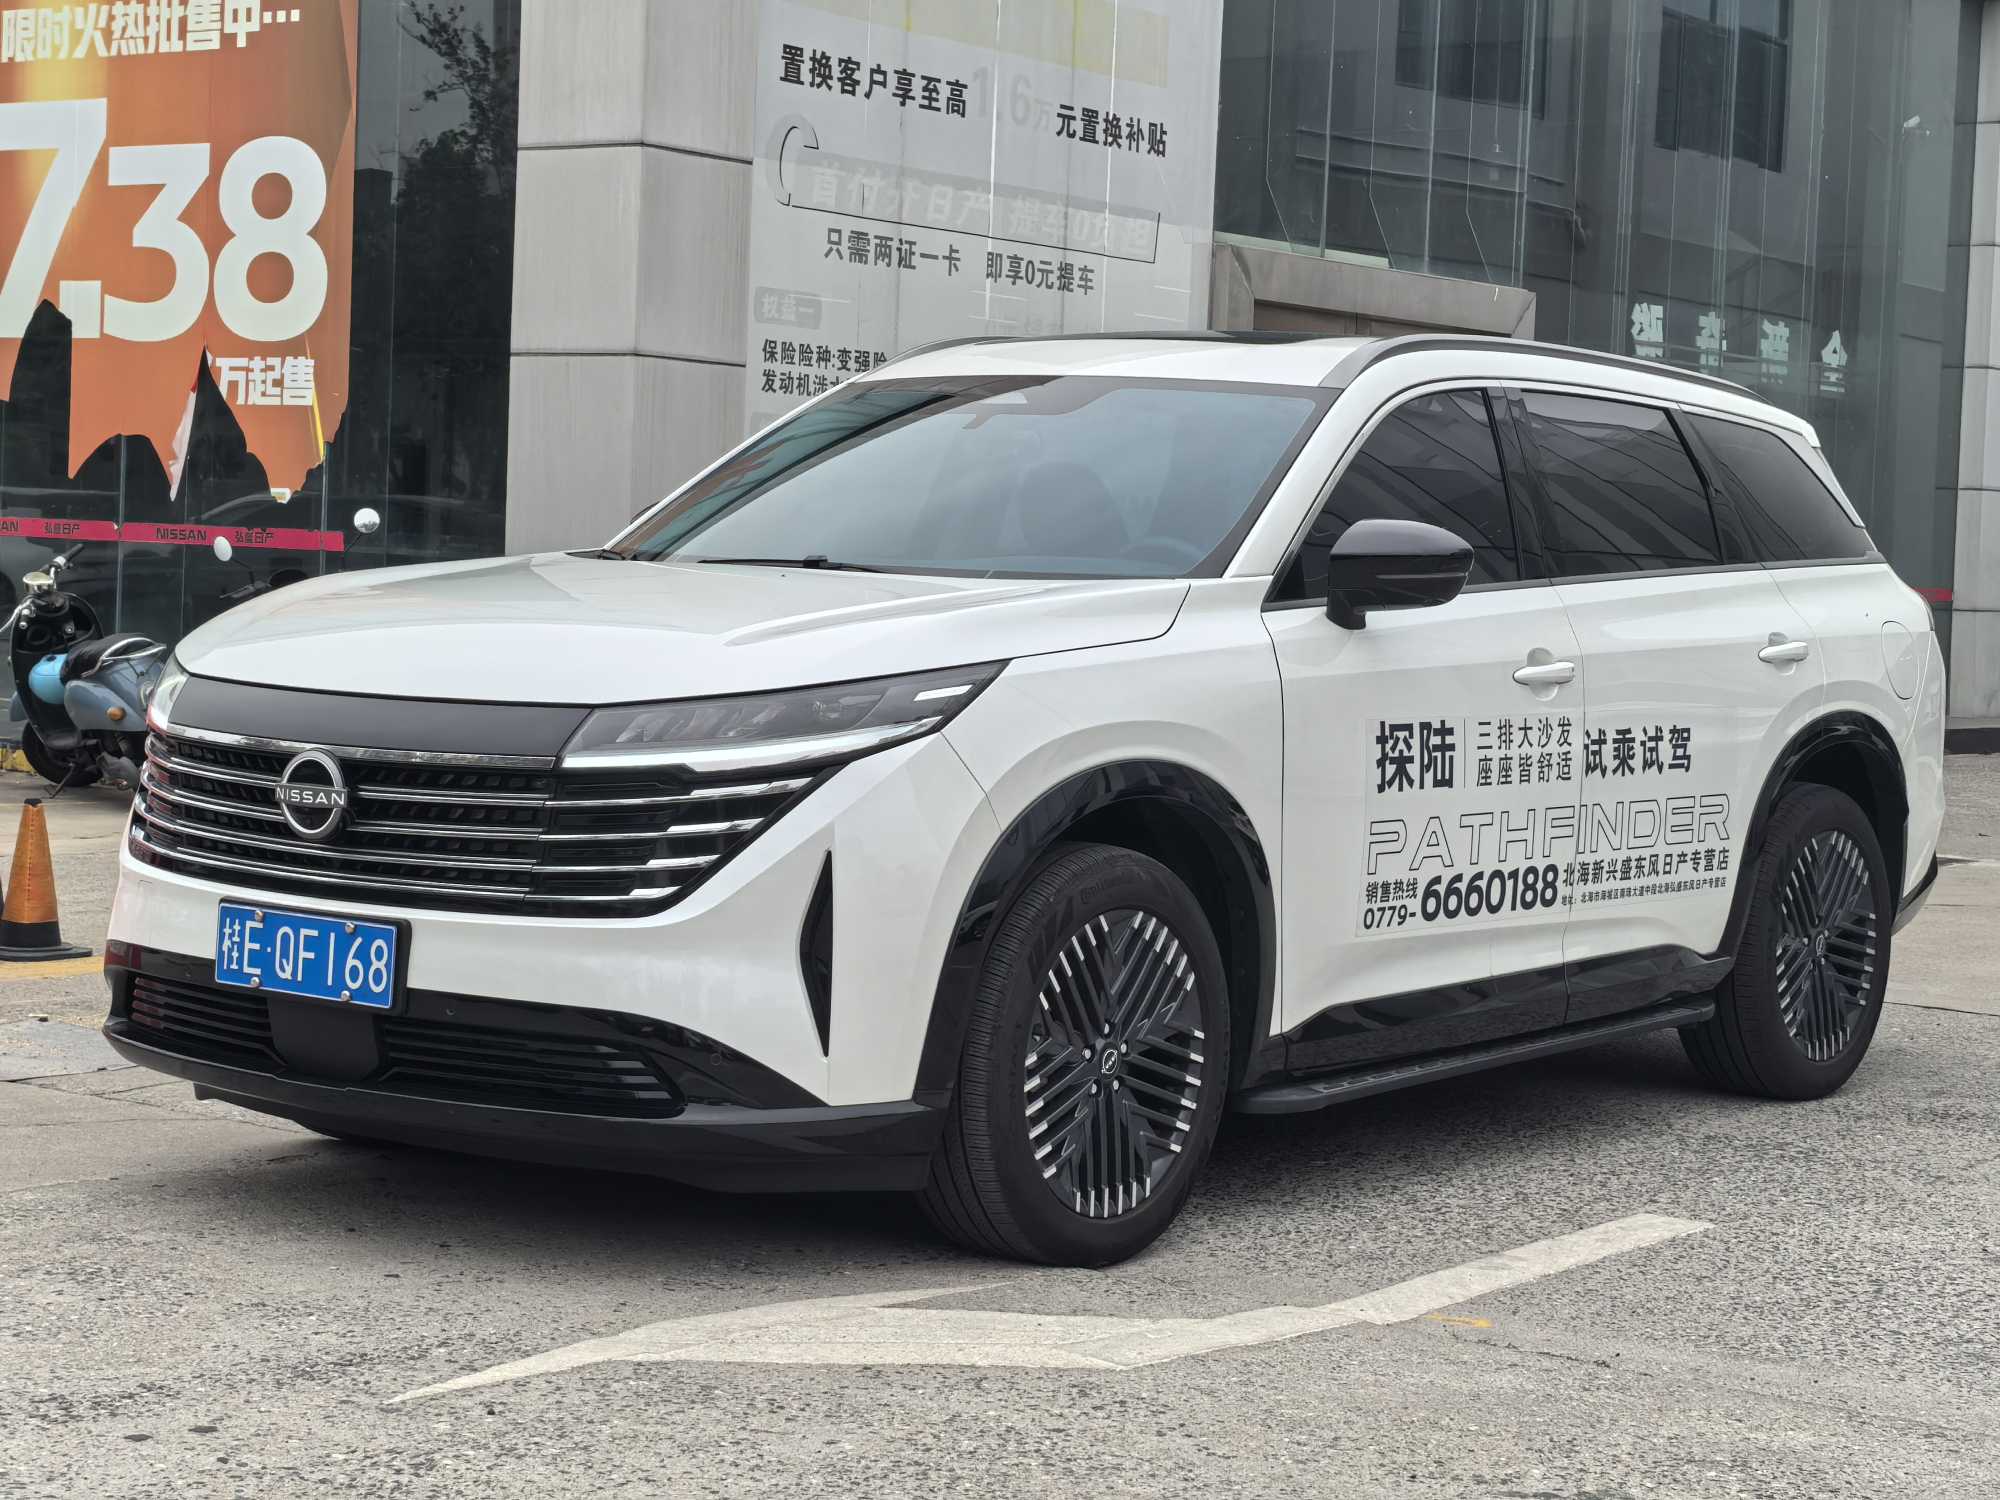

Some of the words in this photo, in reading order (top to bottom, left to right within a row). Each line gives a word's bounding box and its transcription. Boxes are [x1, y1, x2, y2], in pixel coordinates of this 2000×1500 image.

[780, 43, 968, 118] 置换客户享至高
[1056, 104, 1167, 157] 元置换补贴
[0, 97, 328, 342] 7.38
[824, 227, 961, 277] 只需两证一卡
[985, 251, 1095, 295] 即享0元提车
[215, 356, 315, 406] 万起售
[156, 527, 208, 542] NISSAN
[1375, 719, 1457, 794] 探陆
[1475, 715, 1573, 751] 三排大沙发
[1584, 724, 1692, 780] 试乘试驾
[1475, 750, 1573, 788] 座座皆舒适
[275, 786, 346, 806] NISSAN
[1366, 793, 1731, 876] PATHFINDER
[1366, 877, 1419, 904] 销售热线
[1562, 846, 1731, 888] 北海新兴盛东风日产专营店
